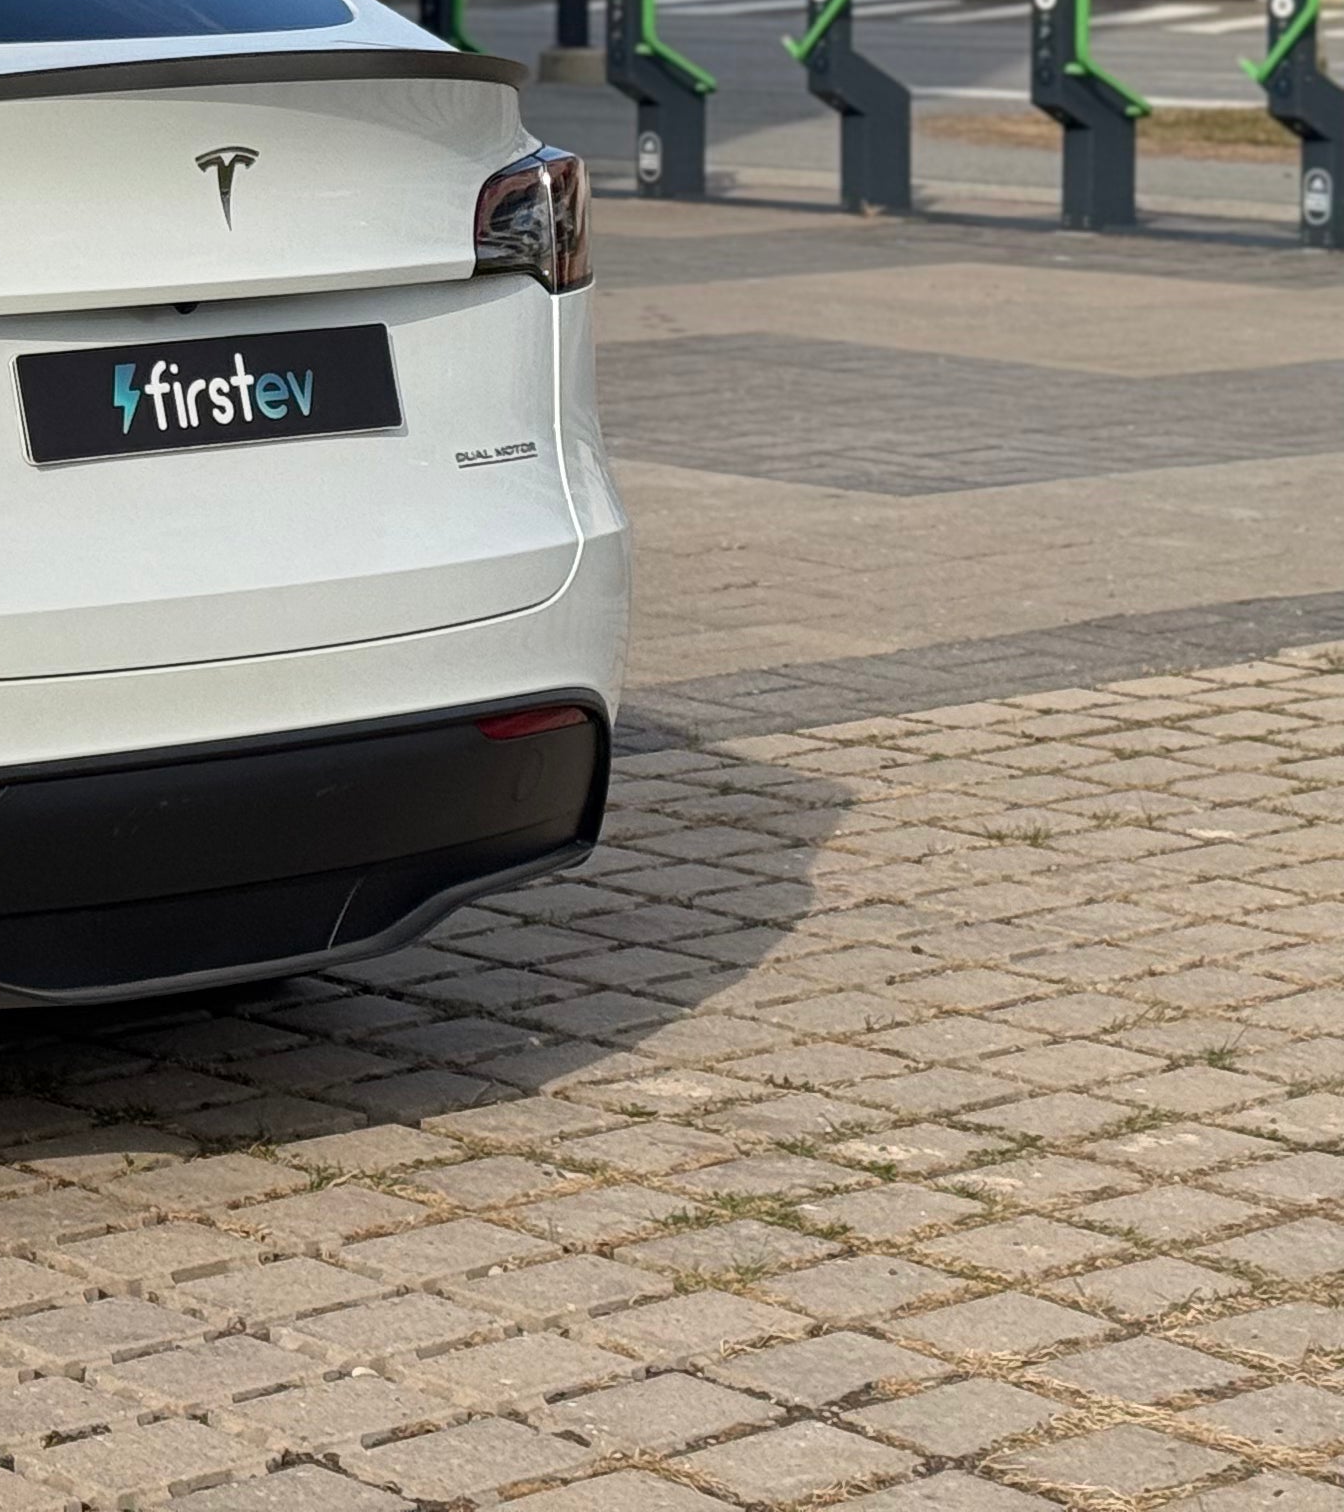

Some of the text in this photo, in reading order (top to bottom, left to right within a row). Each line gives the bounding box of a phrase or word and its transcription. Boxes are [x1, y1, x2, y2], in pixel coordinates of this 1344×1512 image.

[145, 352, 314, 432] firstev
[456, 442, 537, 463] DUAL MOTOR
